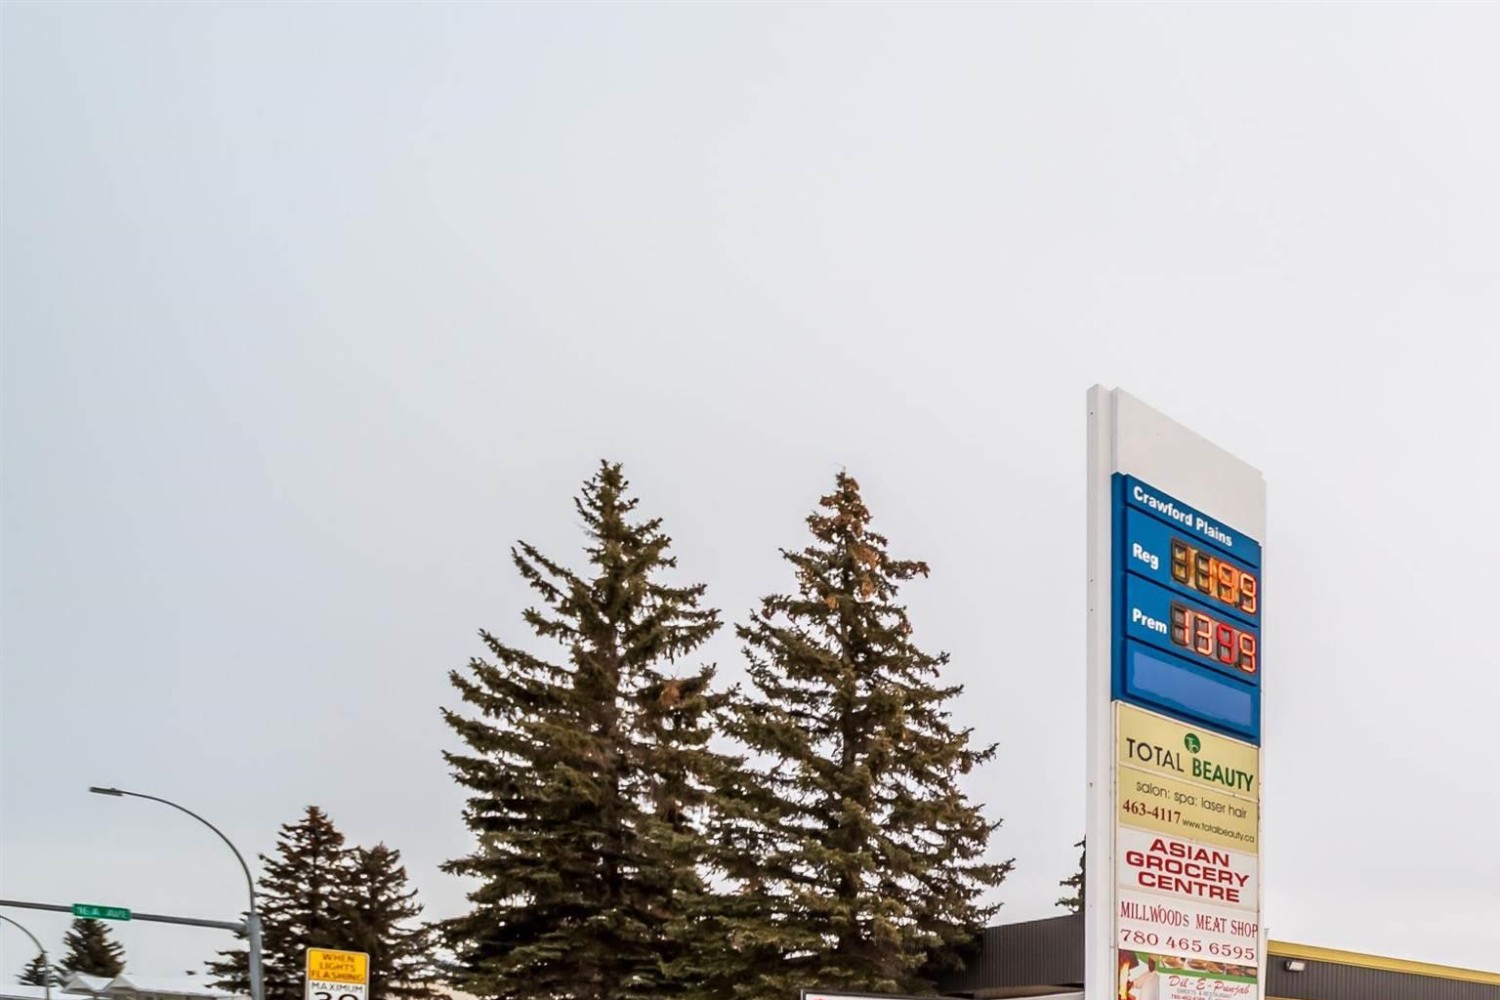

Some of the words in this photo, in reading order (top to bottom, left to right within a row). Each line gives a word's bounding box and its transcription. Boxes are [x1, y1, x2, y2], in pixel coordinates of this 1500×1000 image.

[1133, 485, 1193, 527] Crawford
[1196, 516, 1232, 547] Plains
[1133, 542, 1159, 570] Reg
[1132, 607, 1167, 634] Prem
[1126, 737, 1184, 773] TOTAL
[1192, 757, 1254, 792] BEAUTY
[1122, 799, 1182, 824] 463-4117
[1182, 819, 1255, 843] www.totalbeauty.ca
[1201, 797, 1226, 813] laser
[1228, 804, 1247, 819] hair
[1150, 838, 1229, 868] ASIAN
[1126, 850, 1250, 888] GROCERY
[1138, 872, 1240, 903] CENTRE
[1196, 912, 1227, 932] MEAT
[1231, 919, 1259, 939] SHOP
[322, 953, 355, 963] WHEN
[1120, 928, 1159, 947] 780
[1165, 936, 1202, 953] 465
[1209, 941, 1255, 961] 6595
[310, 969, 364, 982] FLASHING
[319, 961, 356, 973] LIGHTS
[311, 982, 363, 993] MAXIMUM
